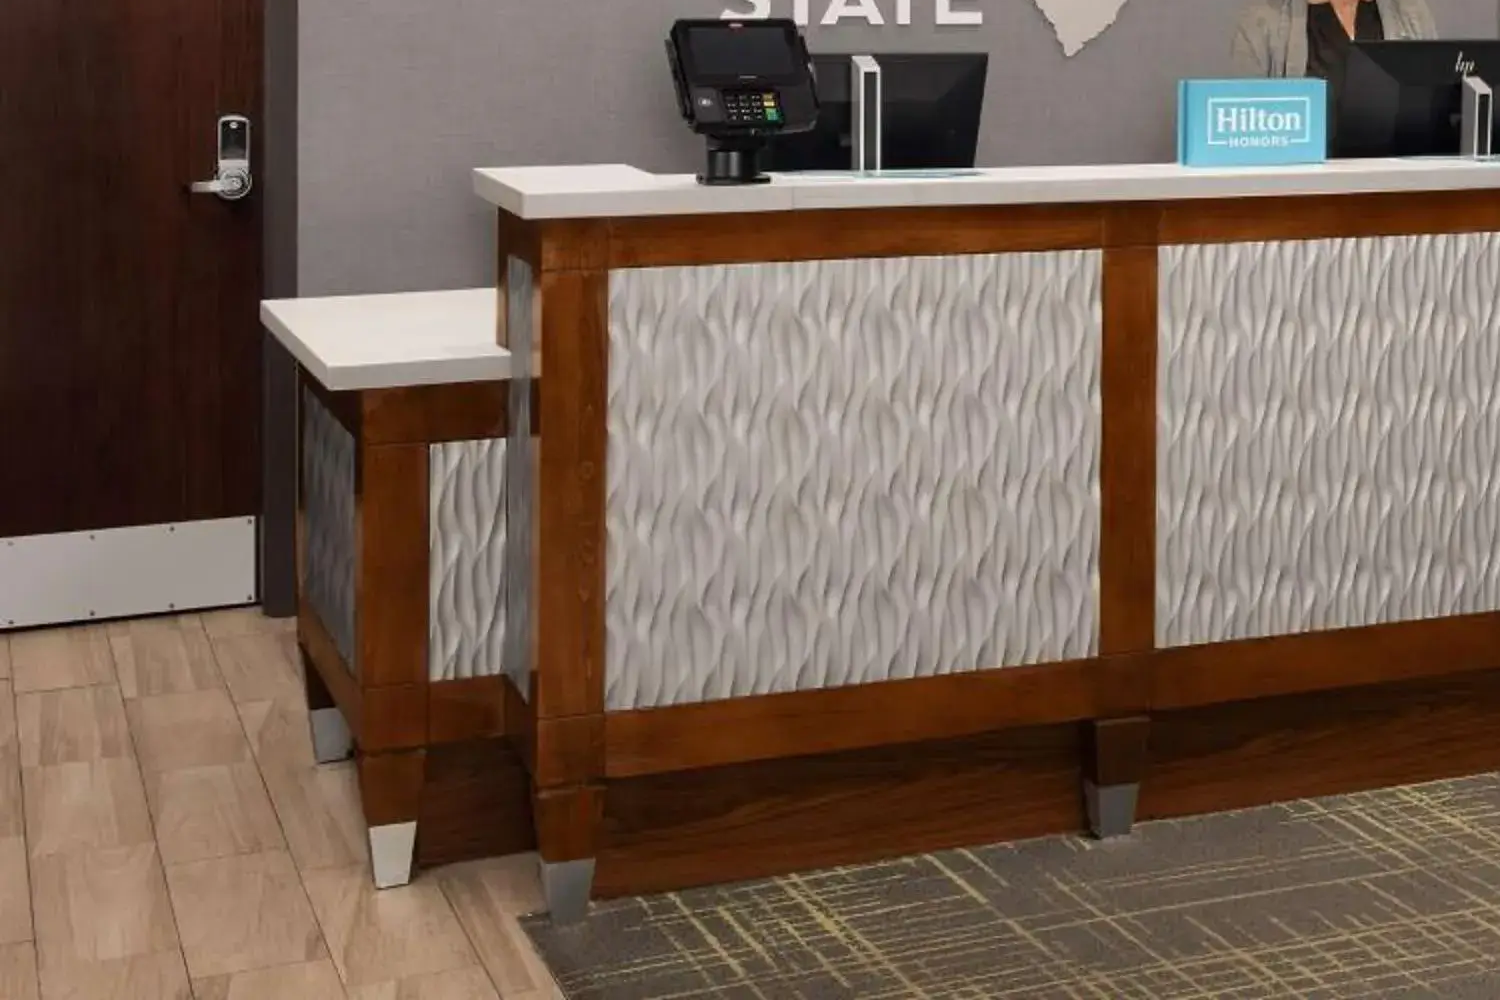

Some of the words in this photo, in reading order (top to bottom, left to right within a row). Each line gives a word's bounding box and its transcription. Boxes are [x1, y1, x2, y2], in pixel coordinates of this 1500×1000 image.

[1455, 51, 1475, 80] hp
[1216, 107, 1302, 133] Hilton
[1228, 135, 1290, 148] HONORS
